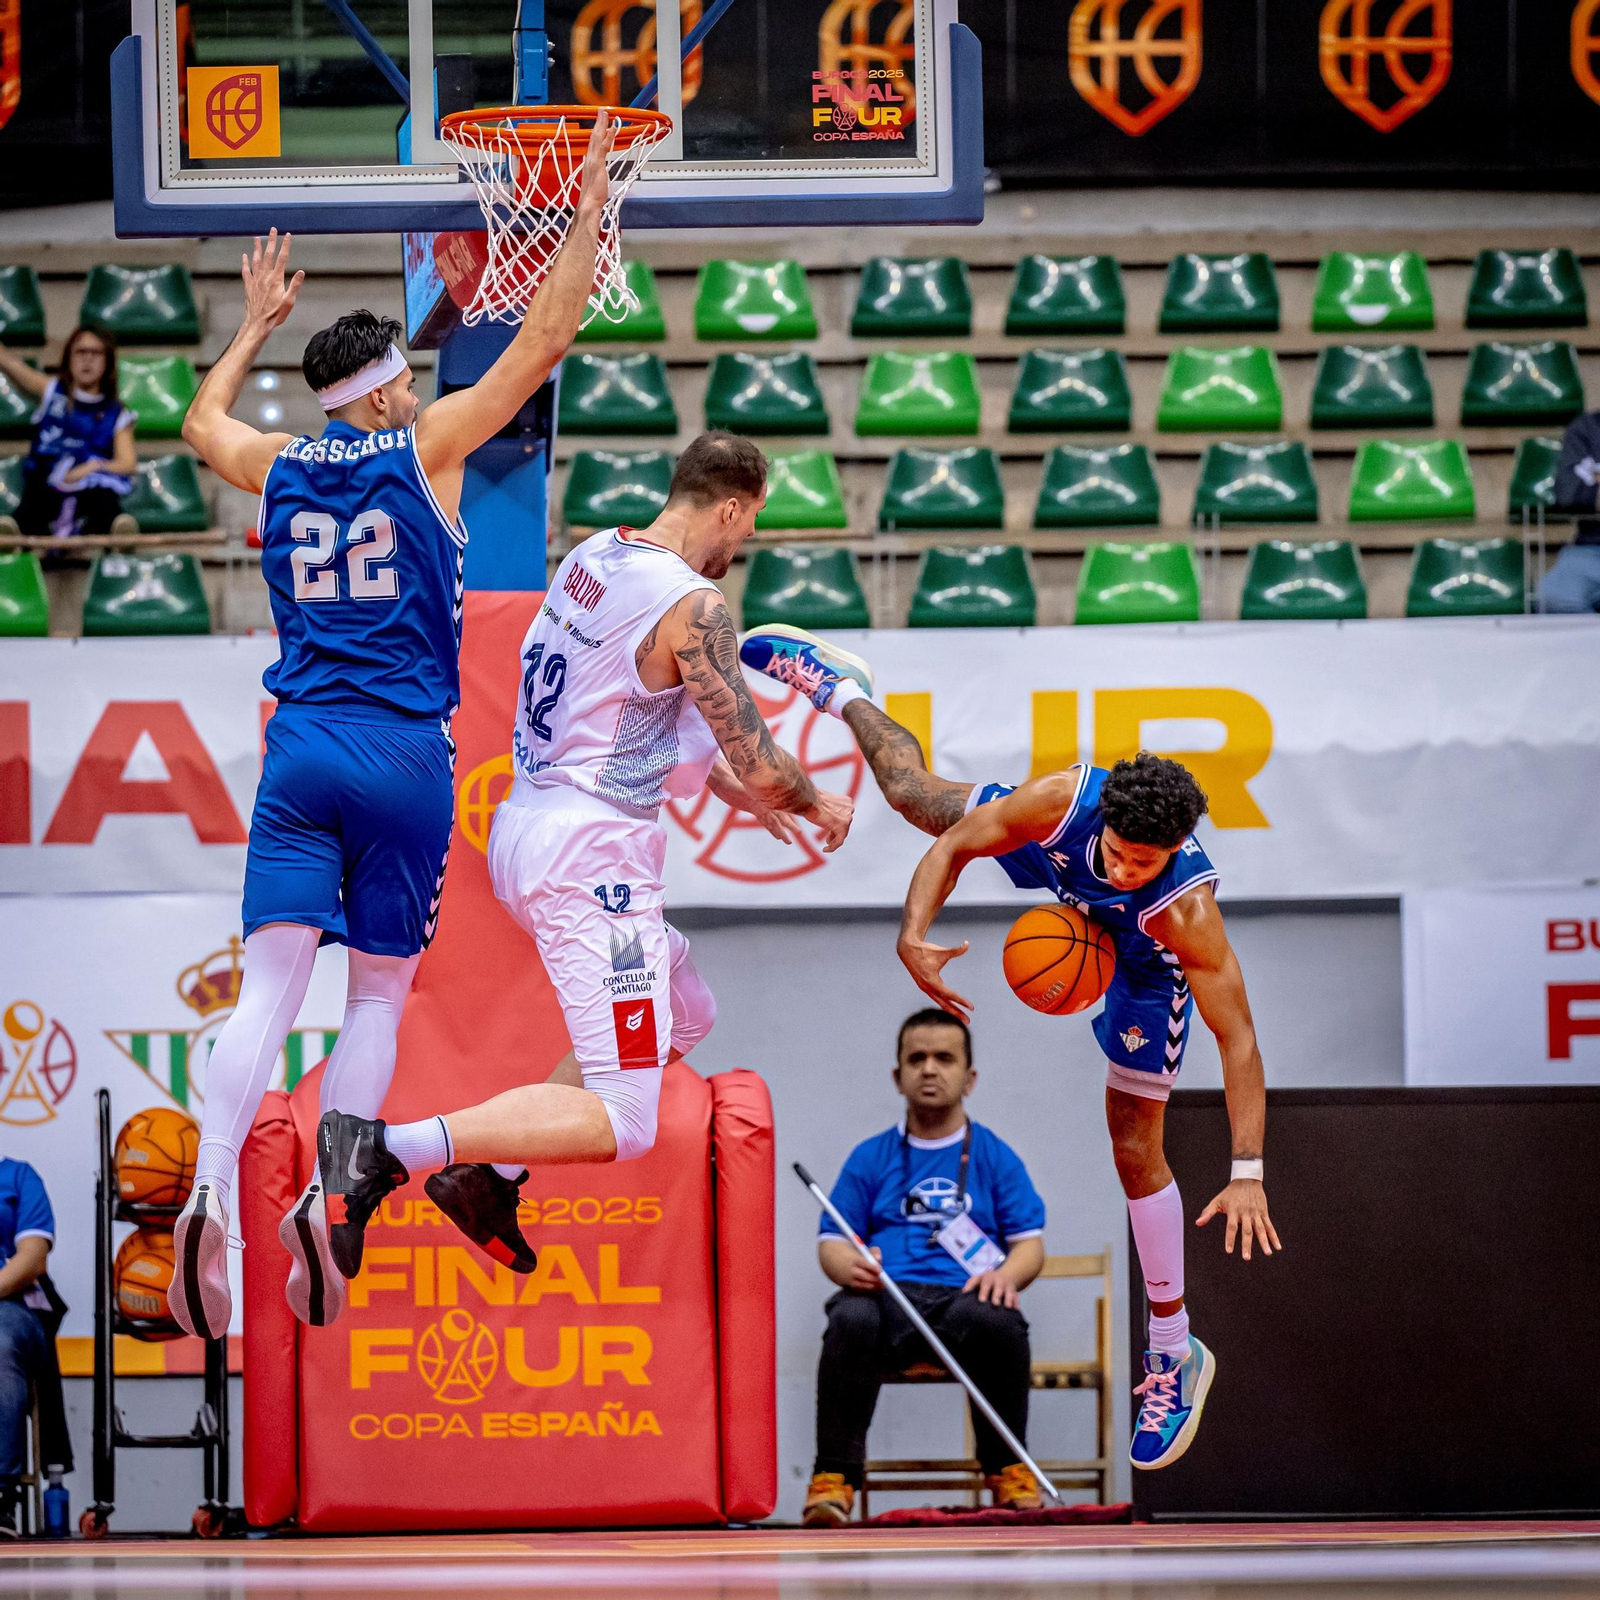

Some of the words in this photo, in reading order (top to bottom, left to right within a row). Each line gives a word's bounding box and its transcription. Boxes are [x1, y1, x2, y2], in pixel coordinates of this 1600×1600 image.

[239, 77, 257, 86] FEB
[812, 83, 904, 103] FINAL
[813, 132, 850, 141] COPA
[851, 129, 905, 140] ESPAÑA
[290, 509, 400, 602] 22
[563, 561, 607, 613] BALVIN
[523, 643, 567, 742] 12
[594, 884, 634, 914] 12
[603, 972, 645, 987] CONCELLO
[647, 971, 658, 981] DE
[611, 982, 652, 996] SANTIAGO
[350, 1244, 662, 1308] FINAL
[350, 1412, 473, 1440] COPA
[481, 1401, 663, 1439] ESPAÑA
